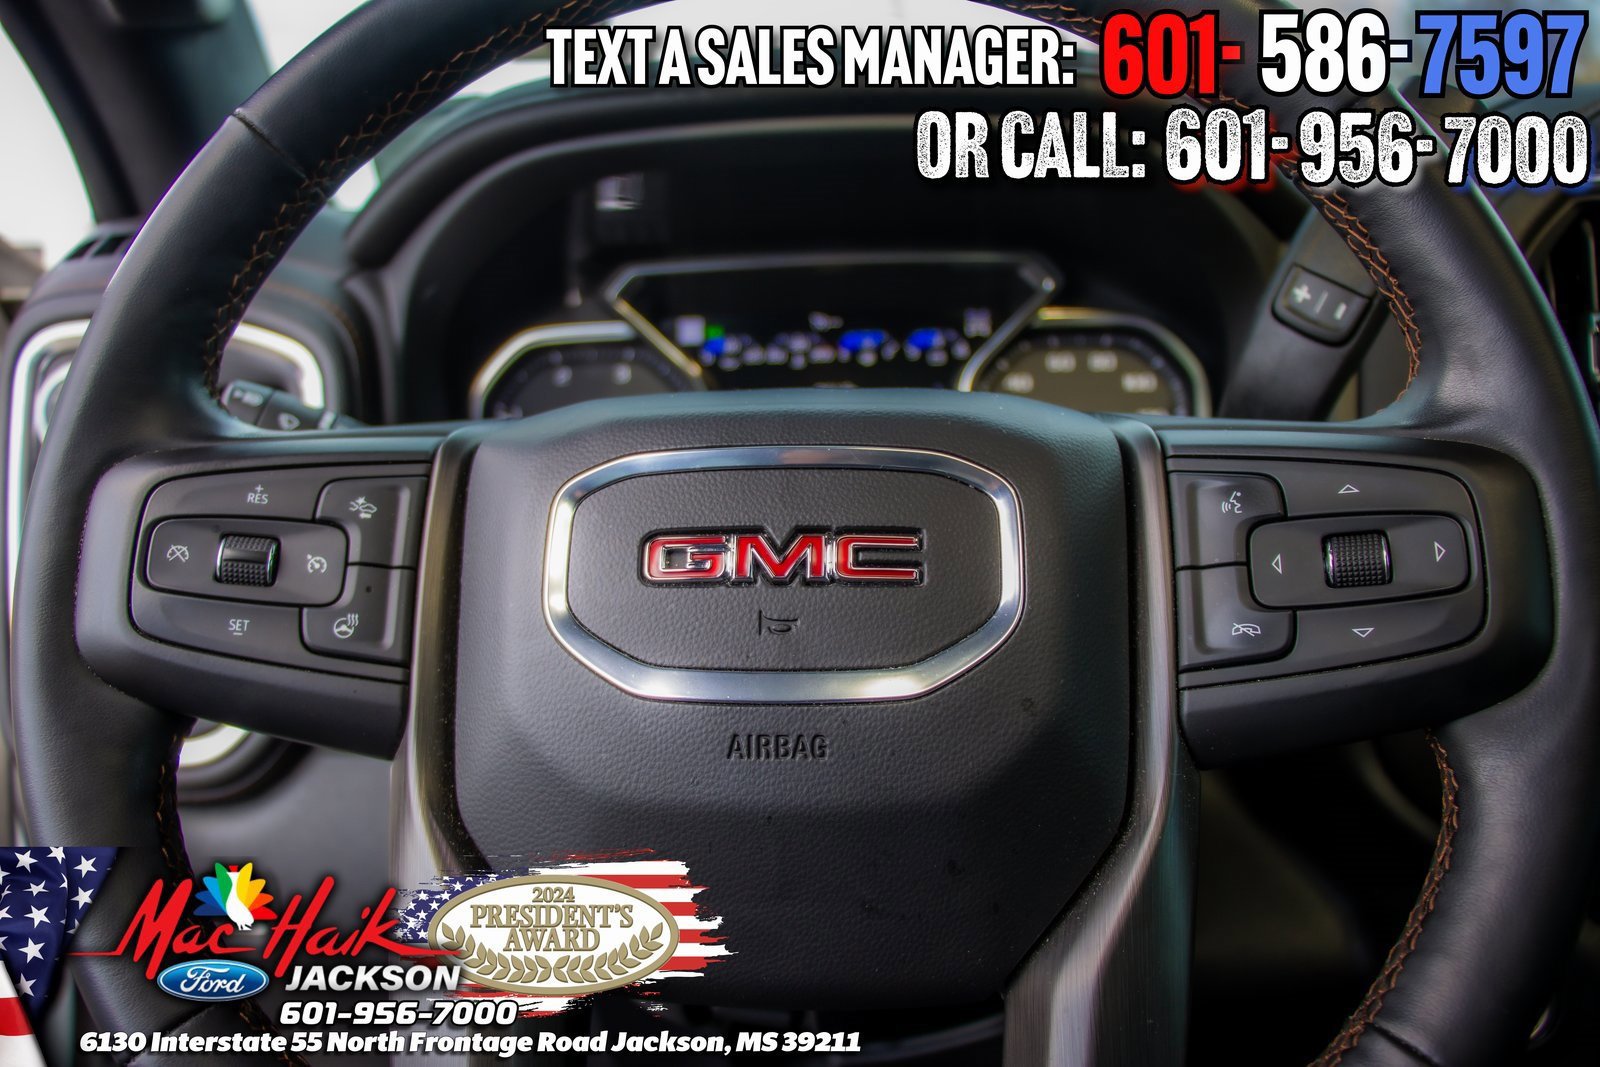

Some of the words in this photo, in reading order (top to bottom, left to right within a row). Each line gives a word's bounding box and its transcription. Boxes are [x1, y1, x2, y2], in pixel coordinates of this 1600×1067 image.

[247, 493, 269, 505] RES
[642, 534, 923, 584] GMC
[228, 618, 250, 632] SET
[727, 734, 829, 760] AIRBAG
